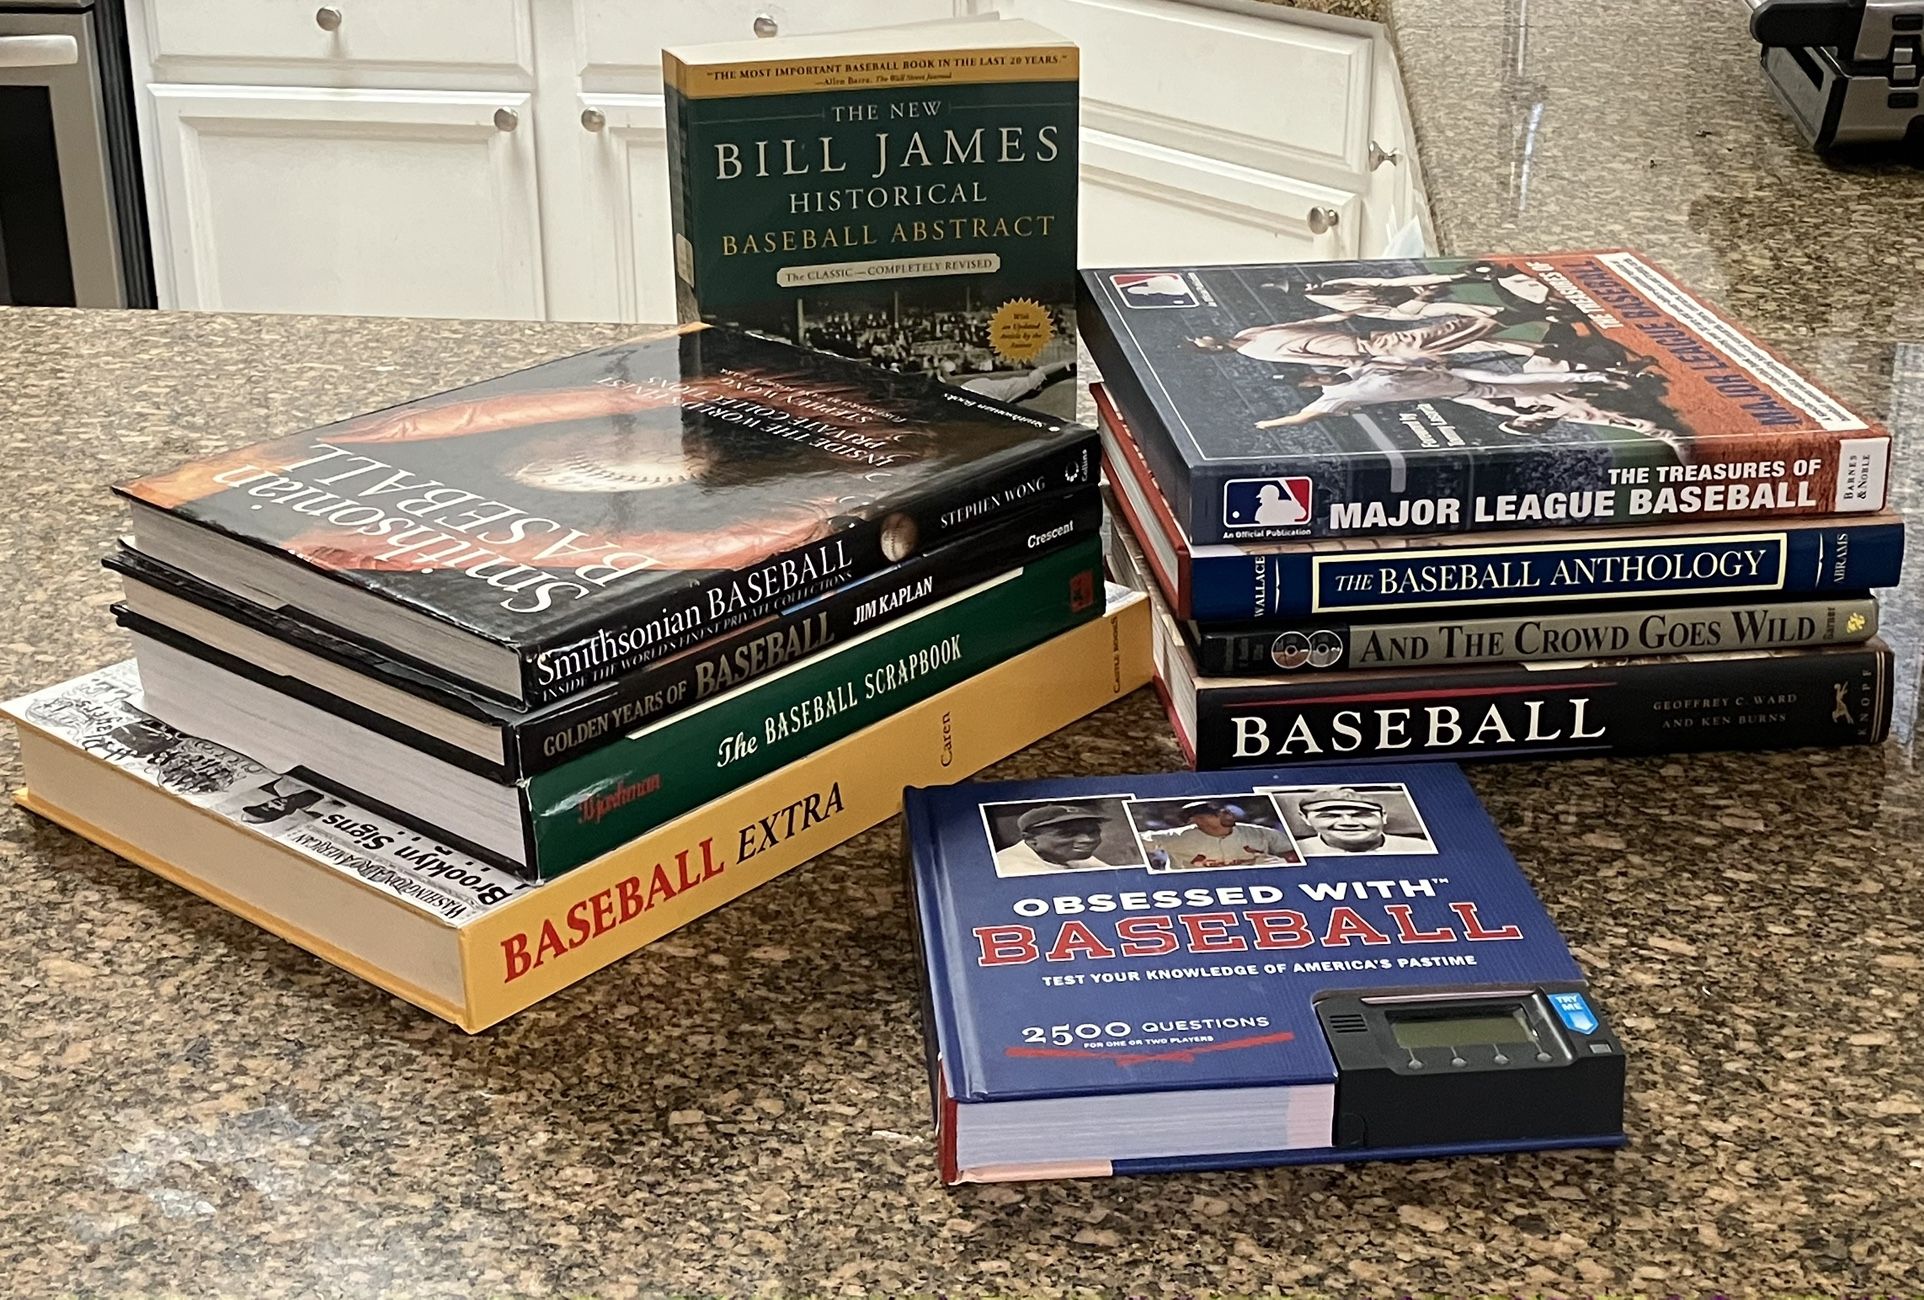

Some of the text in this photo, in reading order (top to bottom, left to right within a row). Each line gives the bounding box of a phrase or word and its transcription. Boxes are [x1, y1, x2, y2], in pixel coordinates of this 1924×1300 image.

[739, 68, 771, 79] MOST
[775, 64, 843, 77] IMPORTANT
[845, 61, 899, 72] BASEBALL
[903, 60, 935, 70] BOOK
[938, 59, 951, 68] IN
[955, 57, 976, 67] THE
[980, 56, 1006, 66] LAST
[1010, 56, 1022, 65] 20
[890, 74, 904, 82] Wall
[906, 73, 925, 81] Street
[926, 72, 952, 81] Journal
[831, 100, 942, 123] THE NEW
[713, 125, 1060, 181] BILL JAMES
[788, 181, 988, 215] HISTORICAL
[722, 215, 1056, 257] BASEBALL ABSTRACT
[785, 271, 805, 283] The
[944, 259, 993, 271] REVISED
[1525, 261, 1625, 330] THE TREASURES OF
[1561, 260, 1804, 426] MAJOR LEAGUE BASEBALL
[593, 376, 670, 401] FINEST
[720, 376, 873, 424] STEPHEN WONG
[943, 392, 1047, 428] Smithsonian Books
[648, 376, 887, 450] PRIVATE COLLECTIONS
[760, 422, 811, 442] THE
[809, 438, 895, 467] INSIDE
[1081, 448, 1089, 482] Collins
[1607, 458, 1823, 485] THE TREASURES OF
[1843, 454, 1858, 500] BARNES
[1857, 454, 1871, 500] & NOBLE
[281, 439, 666, 587] BASEBALL
[939, 475, 1046, 529] STEPHEN WONG
[1329, 481, 1818, 530] MAJOR LEAGUE BASEBALL
[212, 464, 590, 614] Smithsonian
[1027, 520, 1075, 549] Crescent
[1222, 528, 1312, 539] An Official Publication
[1335, 549, 1767, 595] THE BASEBALL ANTHOLOGY
[1833, 532, 1849, 583] ABRAMS
[853, 575, 934, 626] JIM KAPLAN
[1253, 555, 1267, 618] WALLACE
[536, 540, 853, 686] Smithsonian BASEBALL
[543, 676, 587, 702] INSIDE
[593, 663, 617, 682] THE
[679, 622, 721, 648] FINEST
[723, 603, 769, 632] PRIVATE
[773, 571, 853, 611] COLLECTIONS
[1359, 609, 1817, 664] AND THE CROWD GOES WILD
[543, 611, 836, 757] GOLDEN YEARS OF BASEBALL
[716, 633, 962, 768] The BASEBALL SCRAPBOOK
[1652, 698, 1730, 711] GEOFFREY
[1753, 693, 1798, 705] WARD
[1857, 669, 1872, 736] KNOPF
[940, 711, 953, 767] Caren
[1230, 697, 1607, 759] BASEBALL
[1661, 713, 1788, 730] AND KEN BURNS
[321, 813, 395, 851] Signs
[381, 868, 468, 919] WASHINGTON
[393, 845, 514, 906] Brooklyn
[499, 781, 846, 984] BASEBALL EXTRA
[1012, 885, 1285, 918] OBSESSED
[972, 901, 1525, 967] BASEBALL
[1042, 954, 1478, 988] TEST YOUR KNOWLEDGE OF AMERICA'S PASTIME
[1554, 994, 1579, 1004] TRY
[1560, 1002, 1584, 1012] ME
[1021, 1015, 1271, 1047] 2500 QUESTIONS
[1083, 1035, 1215, 1049] FOR ONE OR TWO PLAYERS
